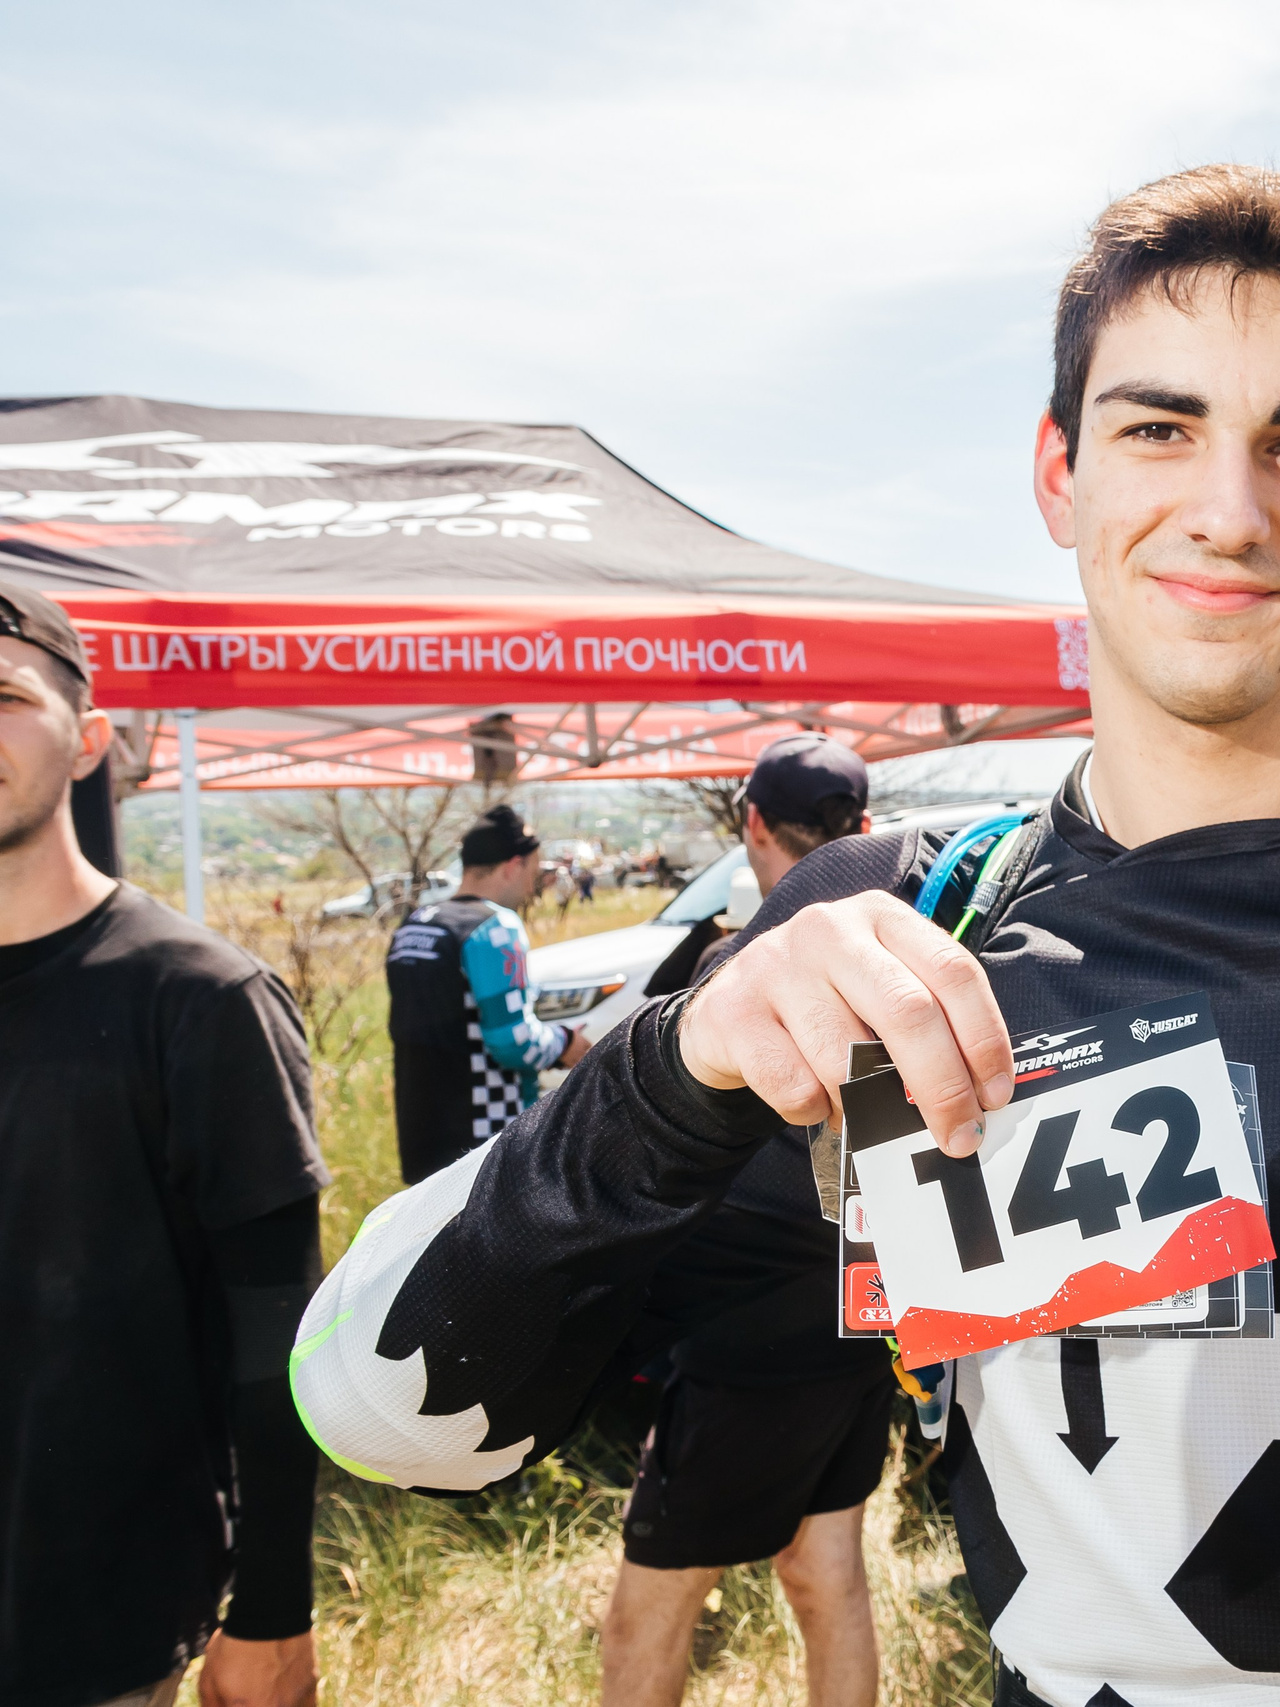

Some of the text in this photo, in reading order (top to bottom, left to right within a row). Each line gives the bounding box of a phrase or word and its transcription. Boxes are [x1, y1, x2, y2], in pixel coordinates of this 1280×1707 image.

[246, 516, 593, 541] MOTORS
[111, 634, 287, 672] ШАТРЫ
[295, 630, 565, 672] УСИЛЕННОЙ
[574, 636, 807, 673] ПРОЧНОСТИ
[1151, 1013, 1199, 1034] JUSTCAT
[1014, 1040, 1104, 1075] ARMAX
[1062, 1054, 1104, 1071] MOTORS
[910, 1085, 1223, 1274] 142
